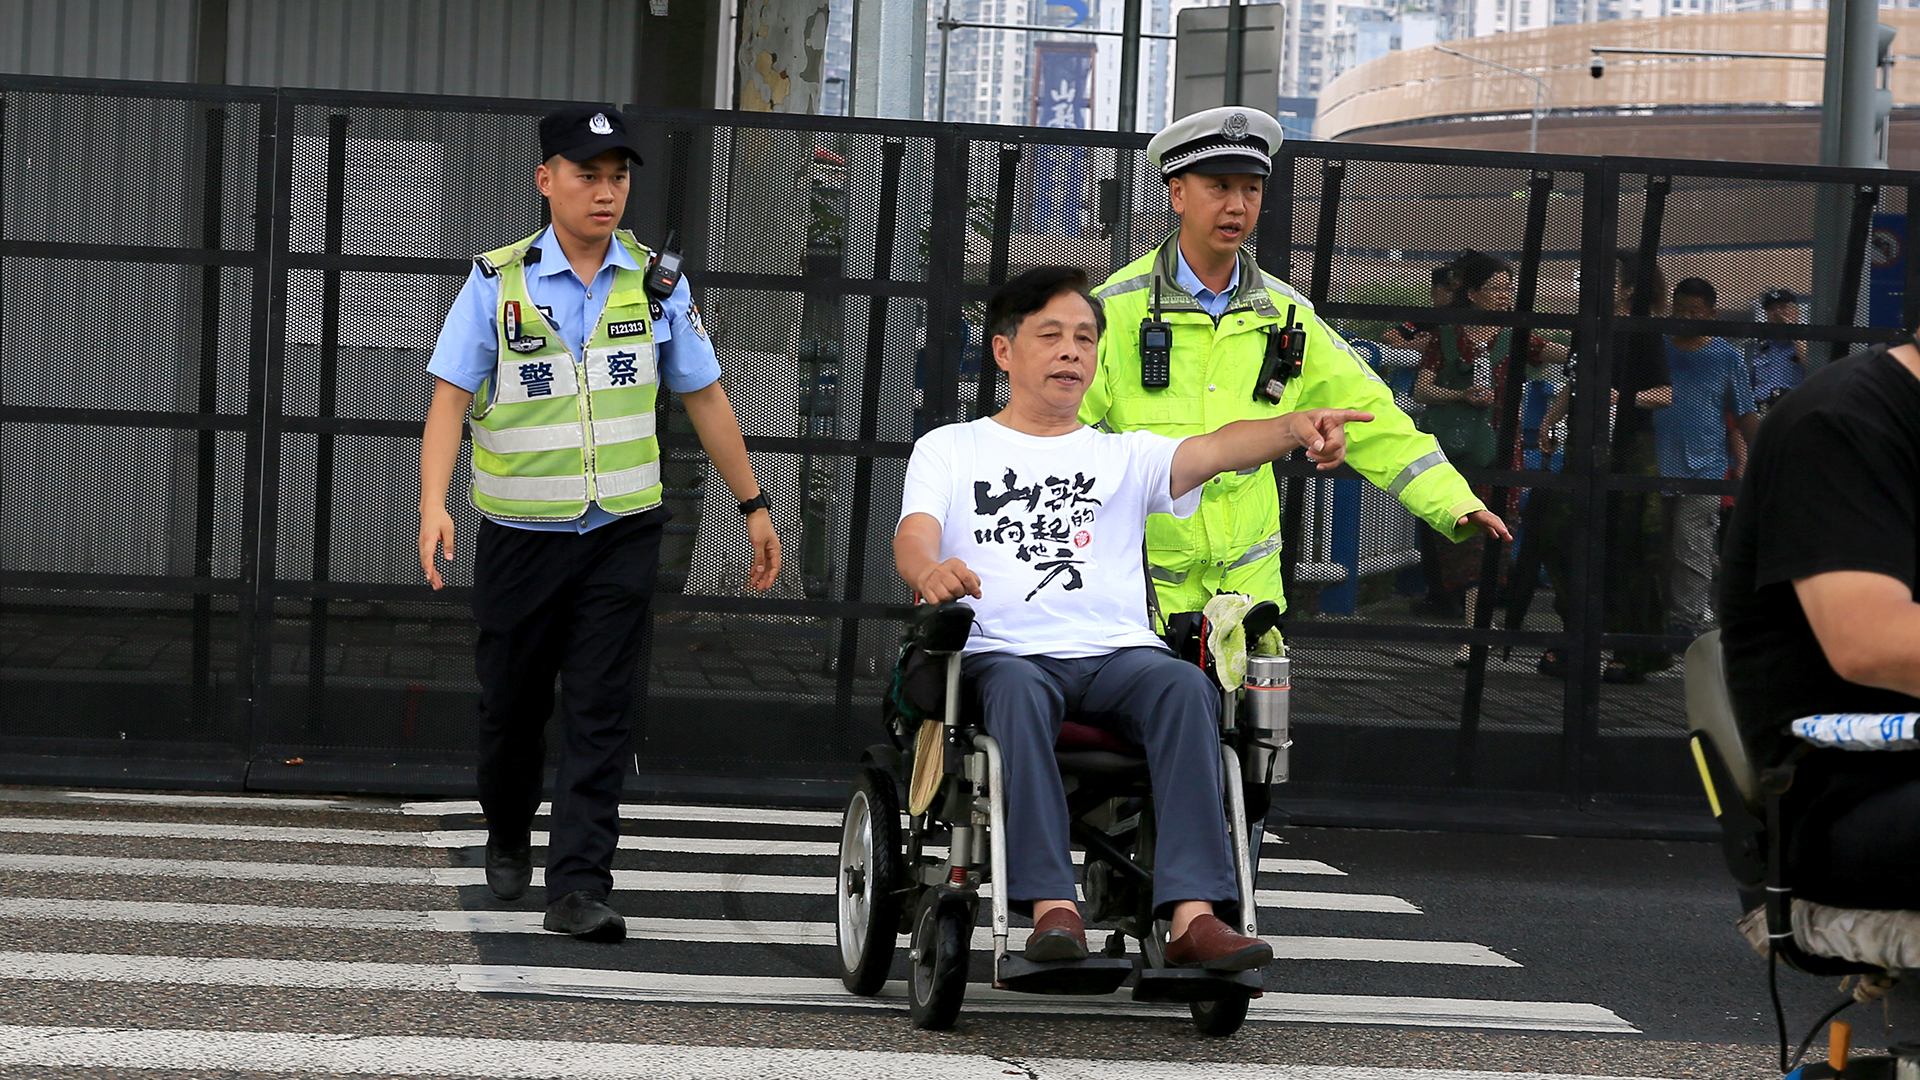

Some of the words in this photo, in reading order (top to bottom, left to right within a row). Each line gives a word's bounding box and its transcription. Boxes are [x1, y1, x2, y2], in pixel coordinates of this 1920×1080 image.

[610, 322, 643, 335] F121313
[974, 466, 1102, 516] 山歌
[1016, 543, 1087, 602] 地方
